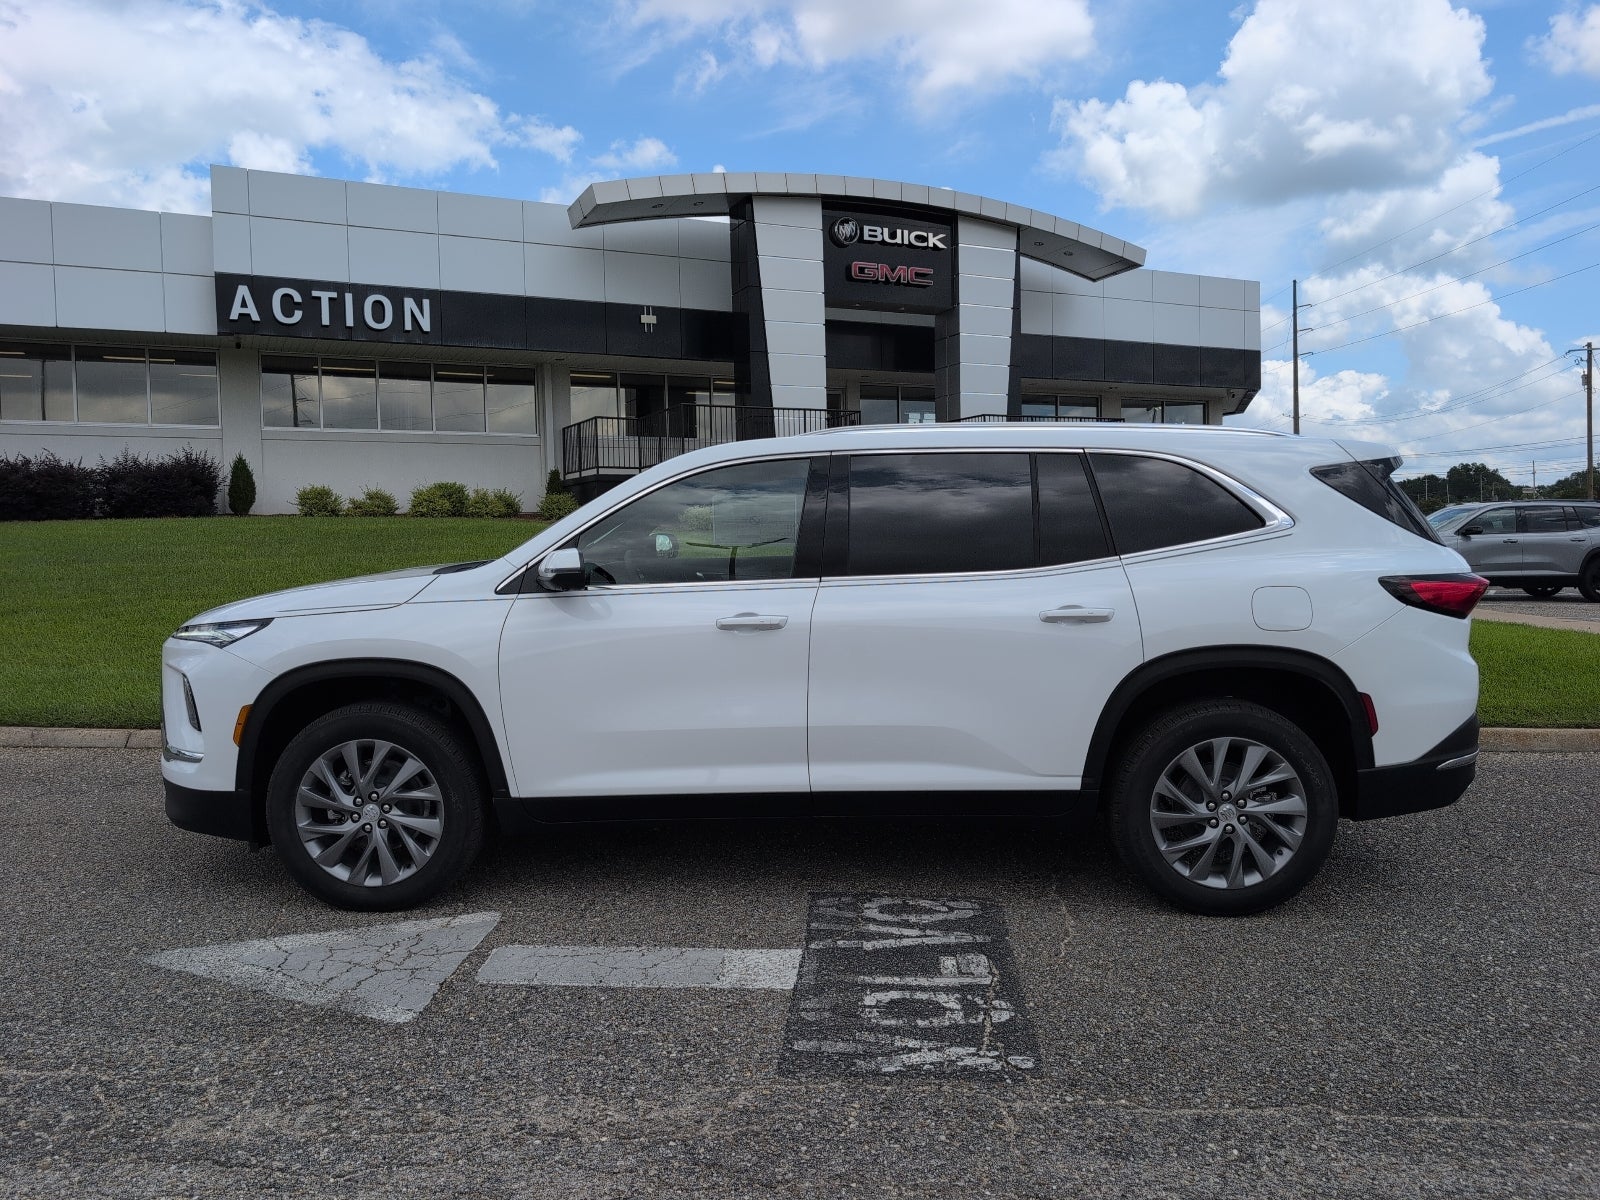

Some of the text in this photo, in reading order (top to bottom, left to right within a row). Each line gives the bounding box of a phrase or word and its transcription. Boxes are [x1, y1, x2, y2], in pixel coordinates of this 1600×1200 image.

[863, 225, 947, 249] BUICK
[851, 261, 934, 286] GMC
[229, 284, 431, 333] ACTION
